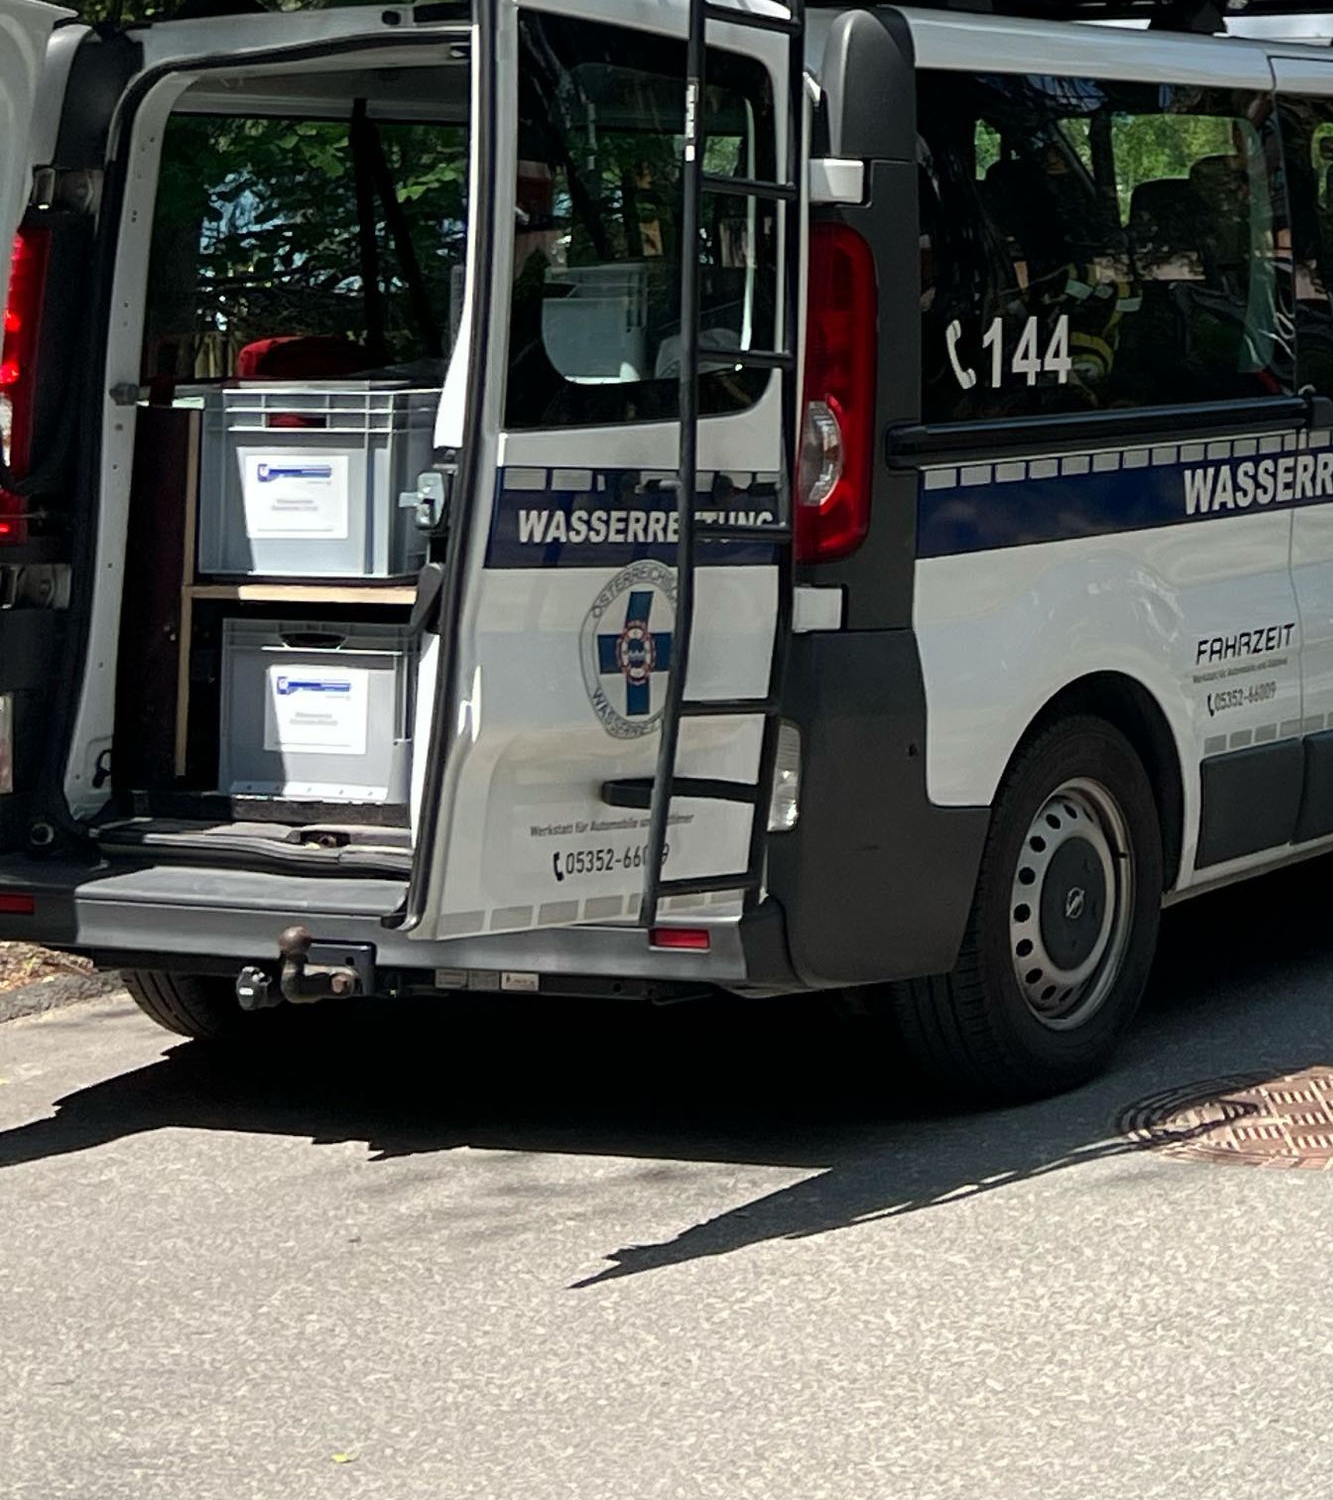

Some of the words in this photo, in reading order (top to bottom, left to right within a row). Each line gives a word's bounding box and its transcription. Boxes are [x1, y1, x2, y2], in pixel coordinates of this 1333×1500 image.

[981, 314, 1073, 388] 144
[518, 509, 774, 543] WASSERRE
[1196, 622, 1296, 666] FAHRZEIT
[566, 842, 671, 875] 05352-669
